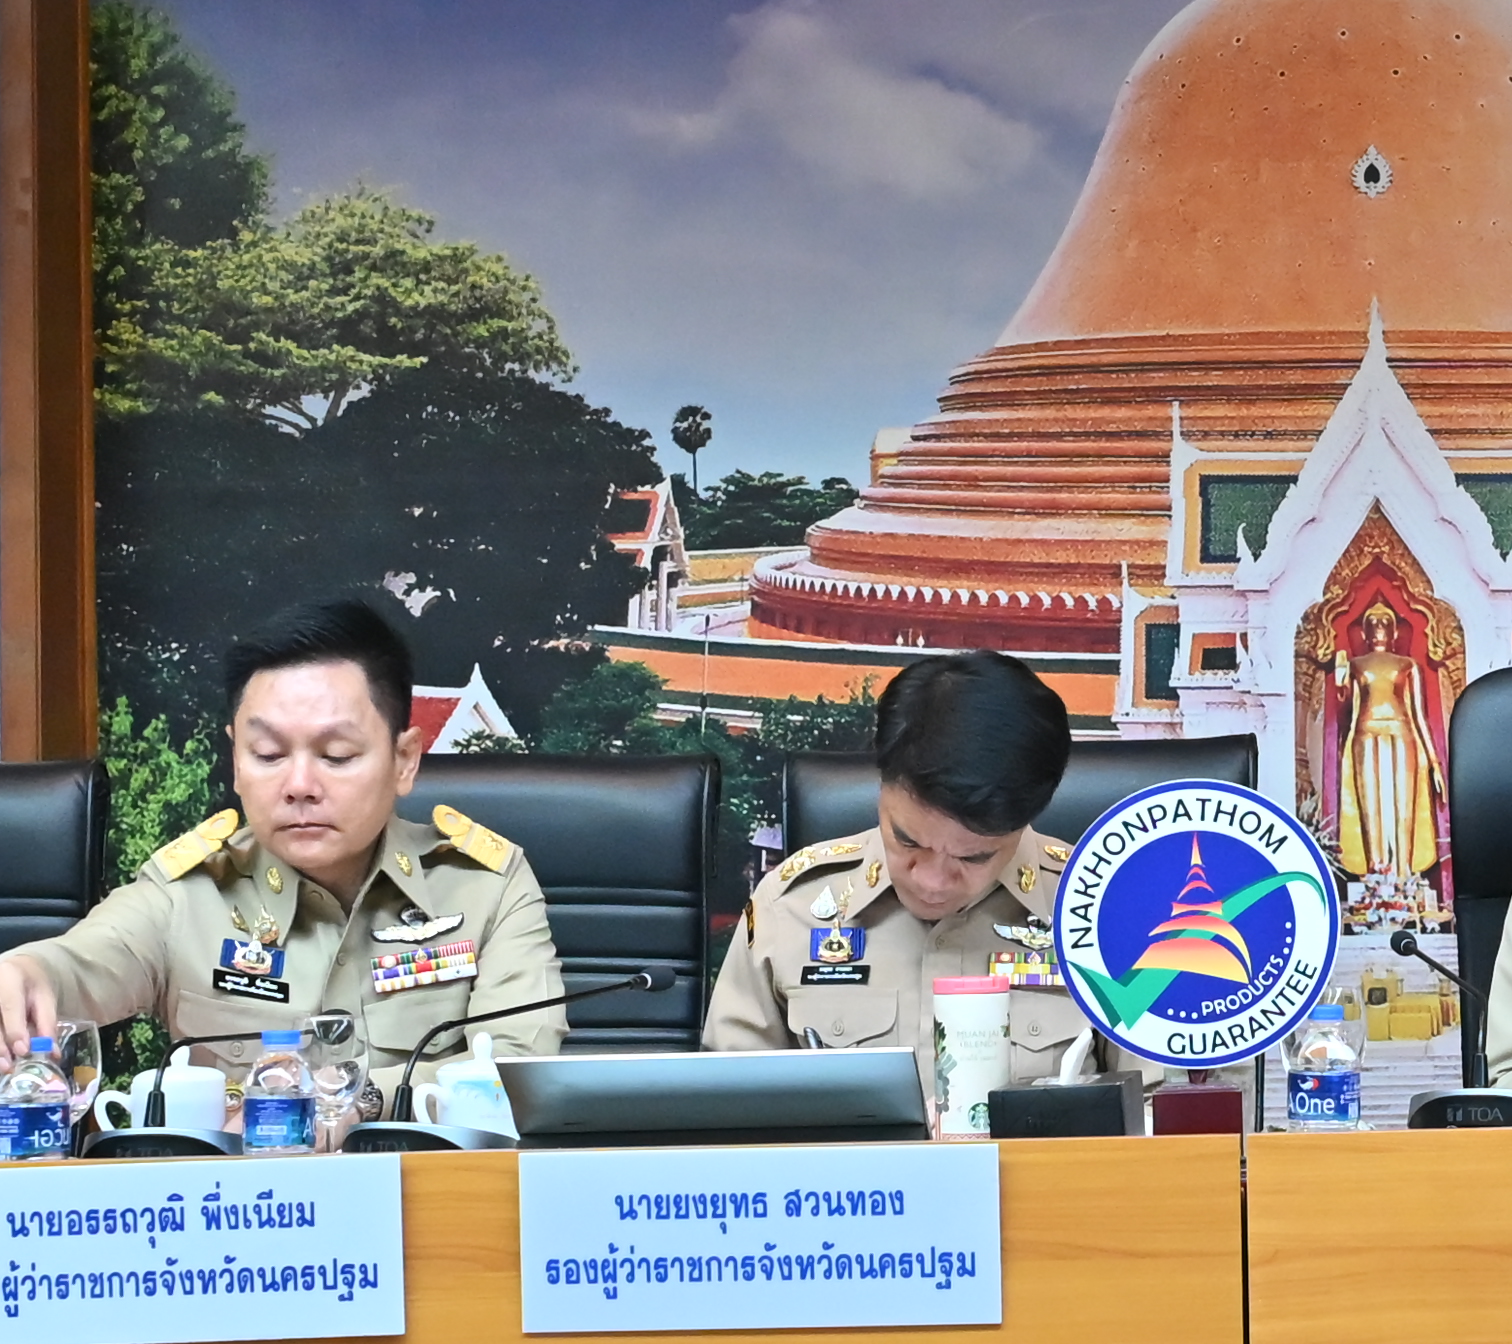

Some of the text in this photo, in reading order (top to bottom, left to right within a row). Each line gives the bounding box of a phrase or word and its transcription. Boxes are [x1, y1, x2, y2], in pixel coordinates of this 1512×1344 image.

[1069, 797, 1289, 950] NAKHONPATHOM
[1166, 958, 1318, 1056] GUARANTEE
[1295, 1091, 1335, 1115] One
[1470, 1107, 1504, 1123] TOA
[5, 1180, 316, 1250] นายอรรถวุฒิ พึ่งเนียม
[614, 1188, 905, 1235] นายยงยุทธ สวนทอง
[545, 1240, 976, 1300] รองผู้ว่าราชการจังหวัดนครปฐม
